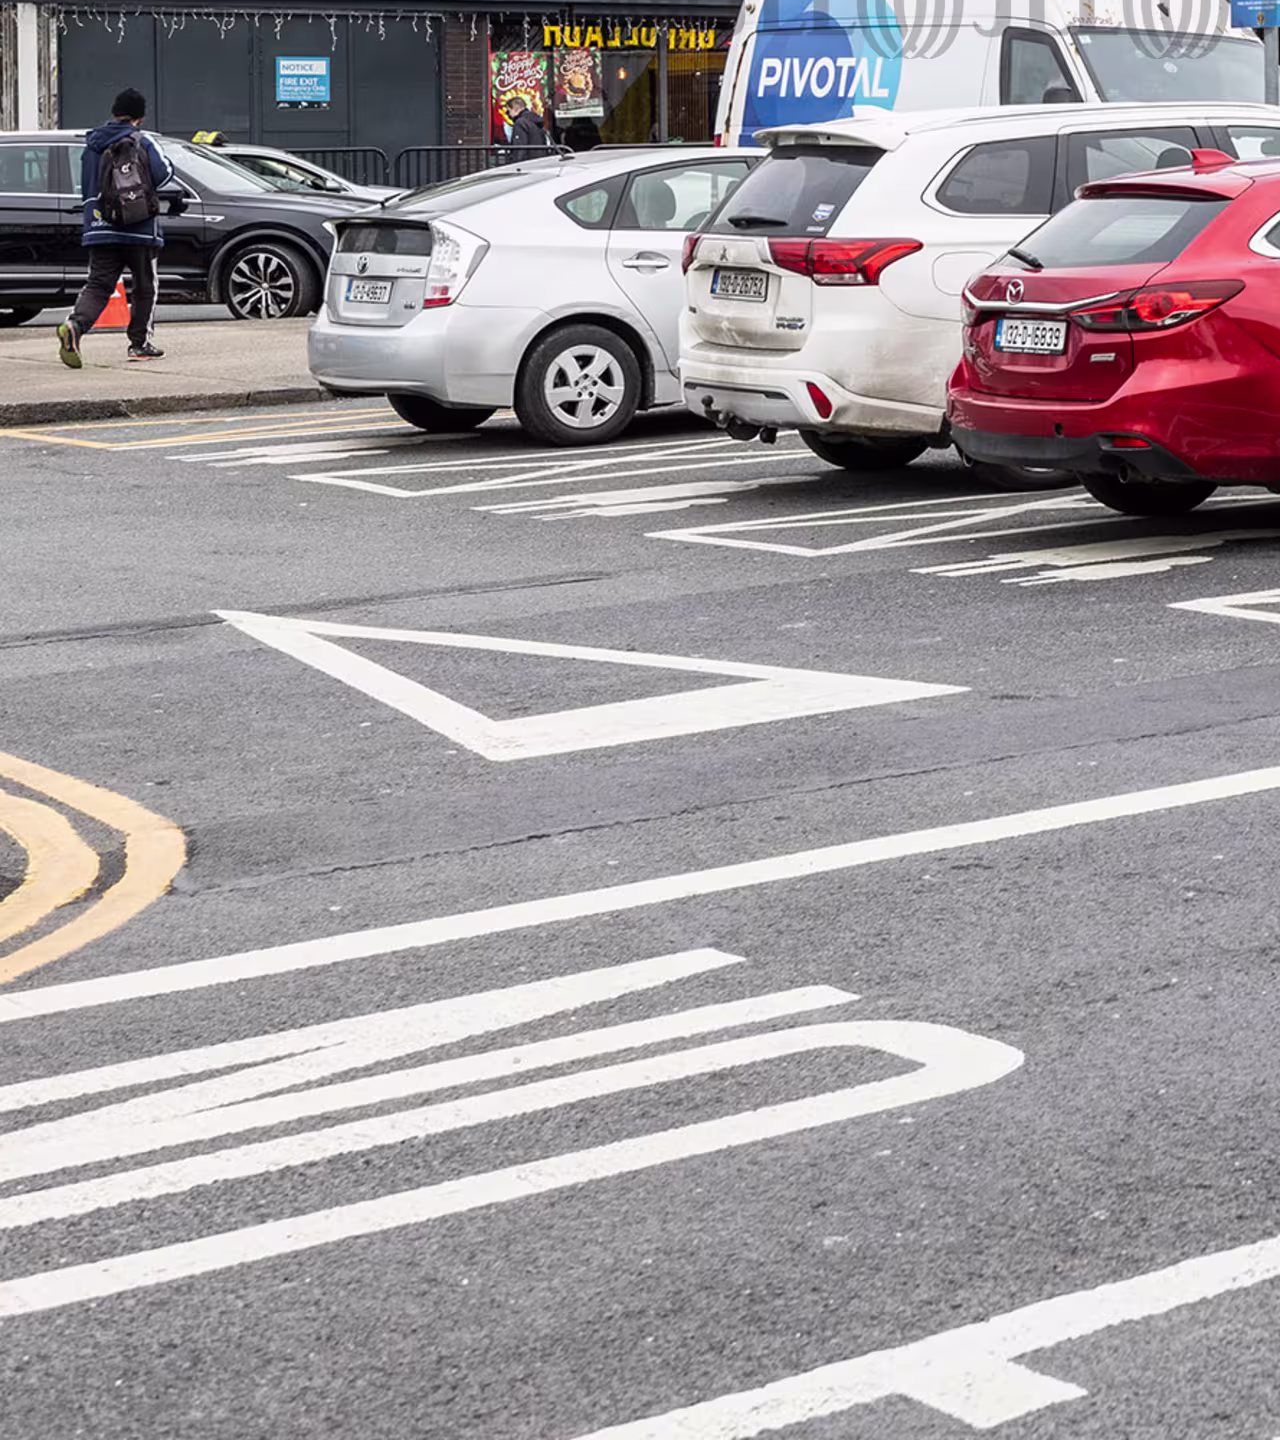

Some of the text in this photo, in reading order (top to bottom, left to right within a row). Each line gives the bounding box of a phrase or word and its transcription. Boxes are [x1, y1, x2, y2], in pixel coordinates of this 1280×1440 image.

[501, 56, 535, 74] Happy
[299, 78, 320, 86] EXIT
[757, 57, 889, 98] PIVOTAL
